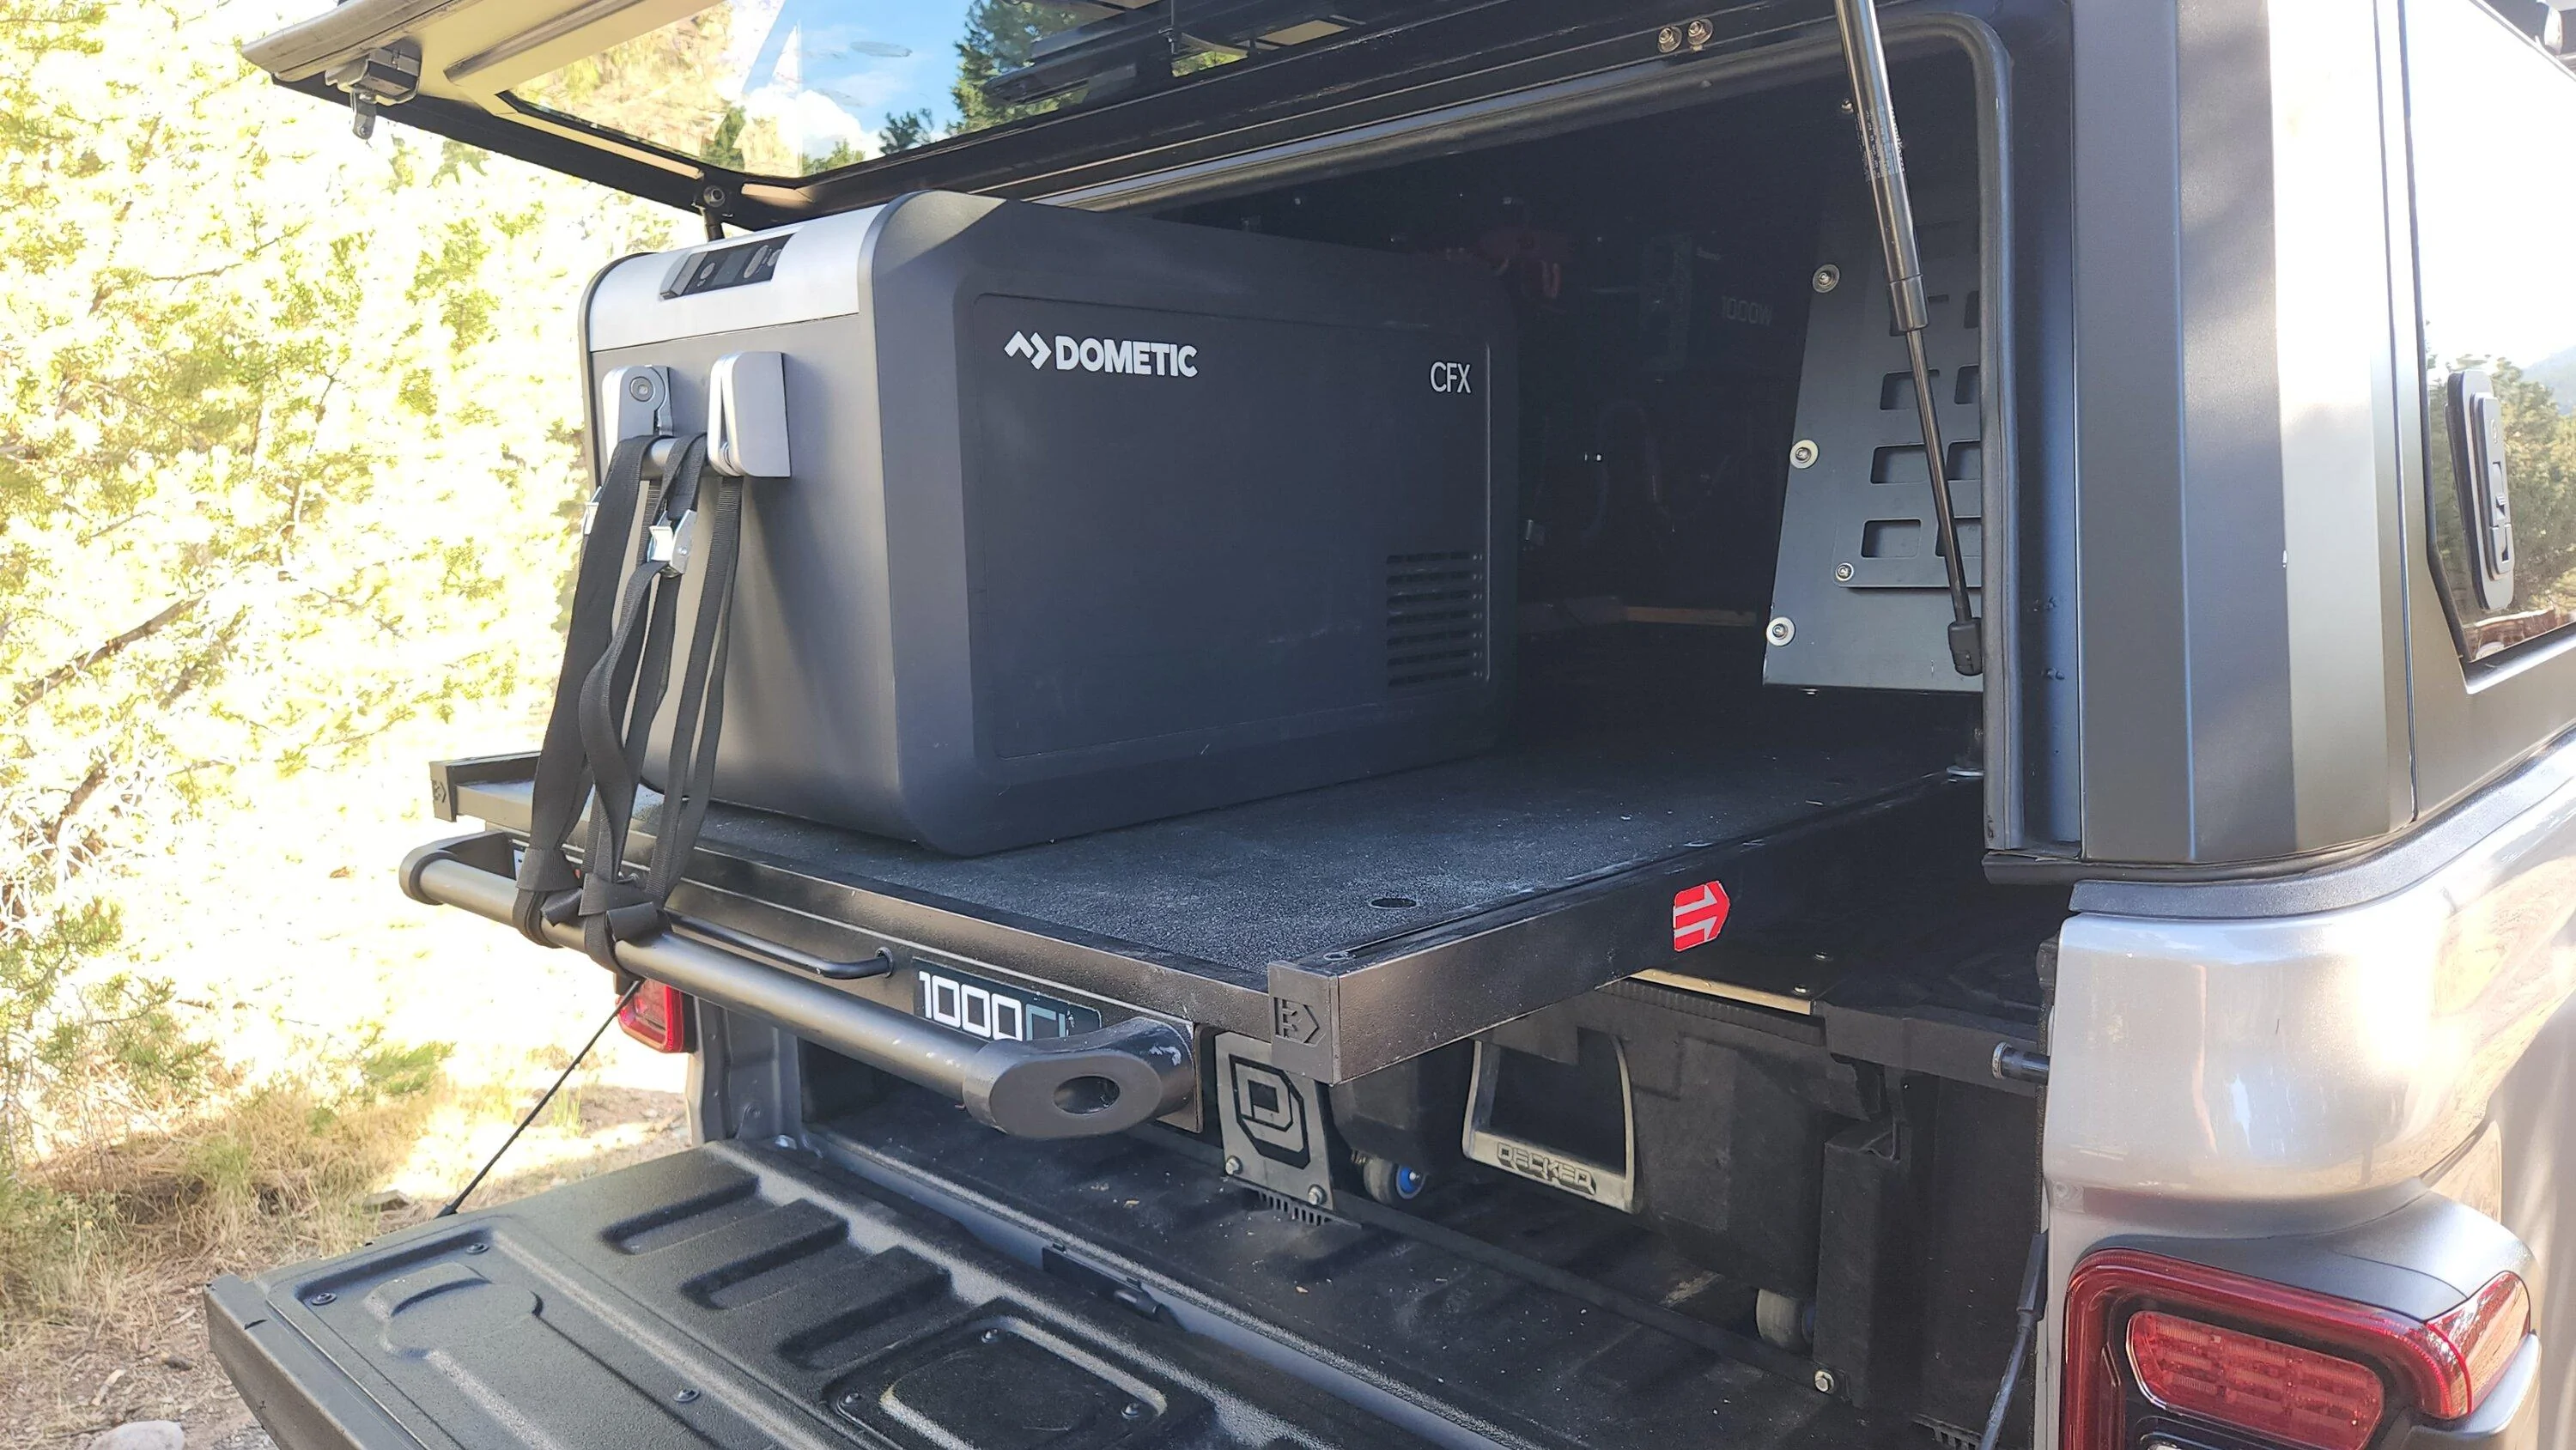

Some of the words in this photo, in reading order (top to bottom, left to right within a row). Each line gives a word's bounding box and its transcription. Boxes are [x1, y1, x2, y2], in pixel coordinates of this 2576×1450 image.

[1054, 335, 1198, 378] DOMETIC
[1430, 361, 1472, 393] CFX
[1498, 1142, 1596, 1195] DECKED
